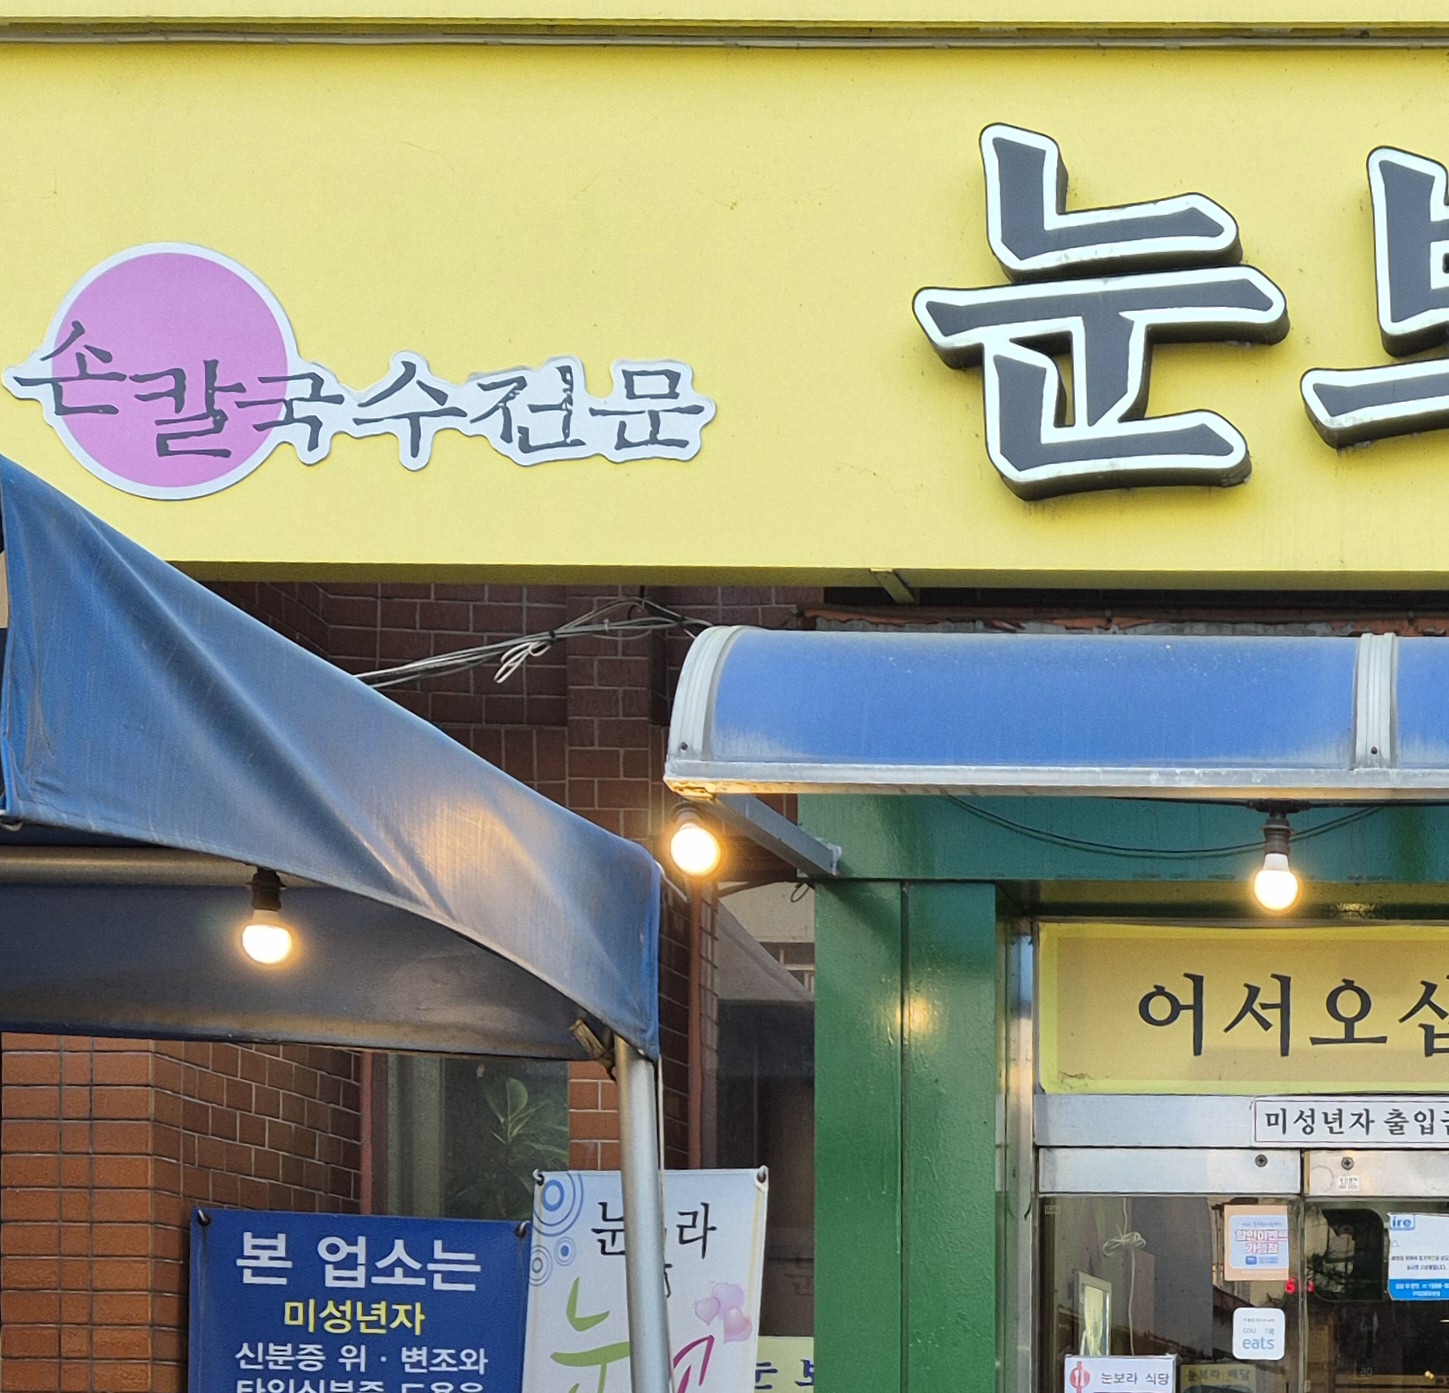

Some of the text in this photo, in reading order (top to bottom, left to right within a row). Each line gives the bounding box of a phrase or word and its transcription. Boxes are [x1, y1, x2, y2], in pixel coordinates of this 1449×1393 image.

[13, 320, 706, 458] 손칼국수전문
[1265, 1108, 1376, 1138] 미성년자
[591, 1201, 717, 1259] 눈라
[236, 1231, 482, 1291] 본 업소는
[283, 1299, 425, 1336] 미성년자
[235, 1342, 488, 1375] 신분증 위 변조와
[1243, 1337, 1275, 1350] eats
[1101, 1372, 1169, 1386] 눈보라 식당
